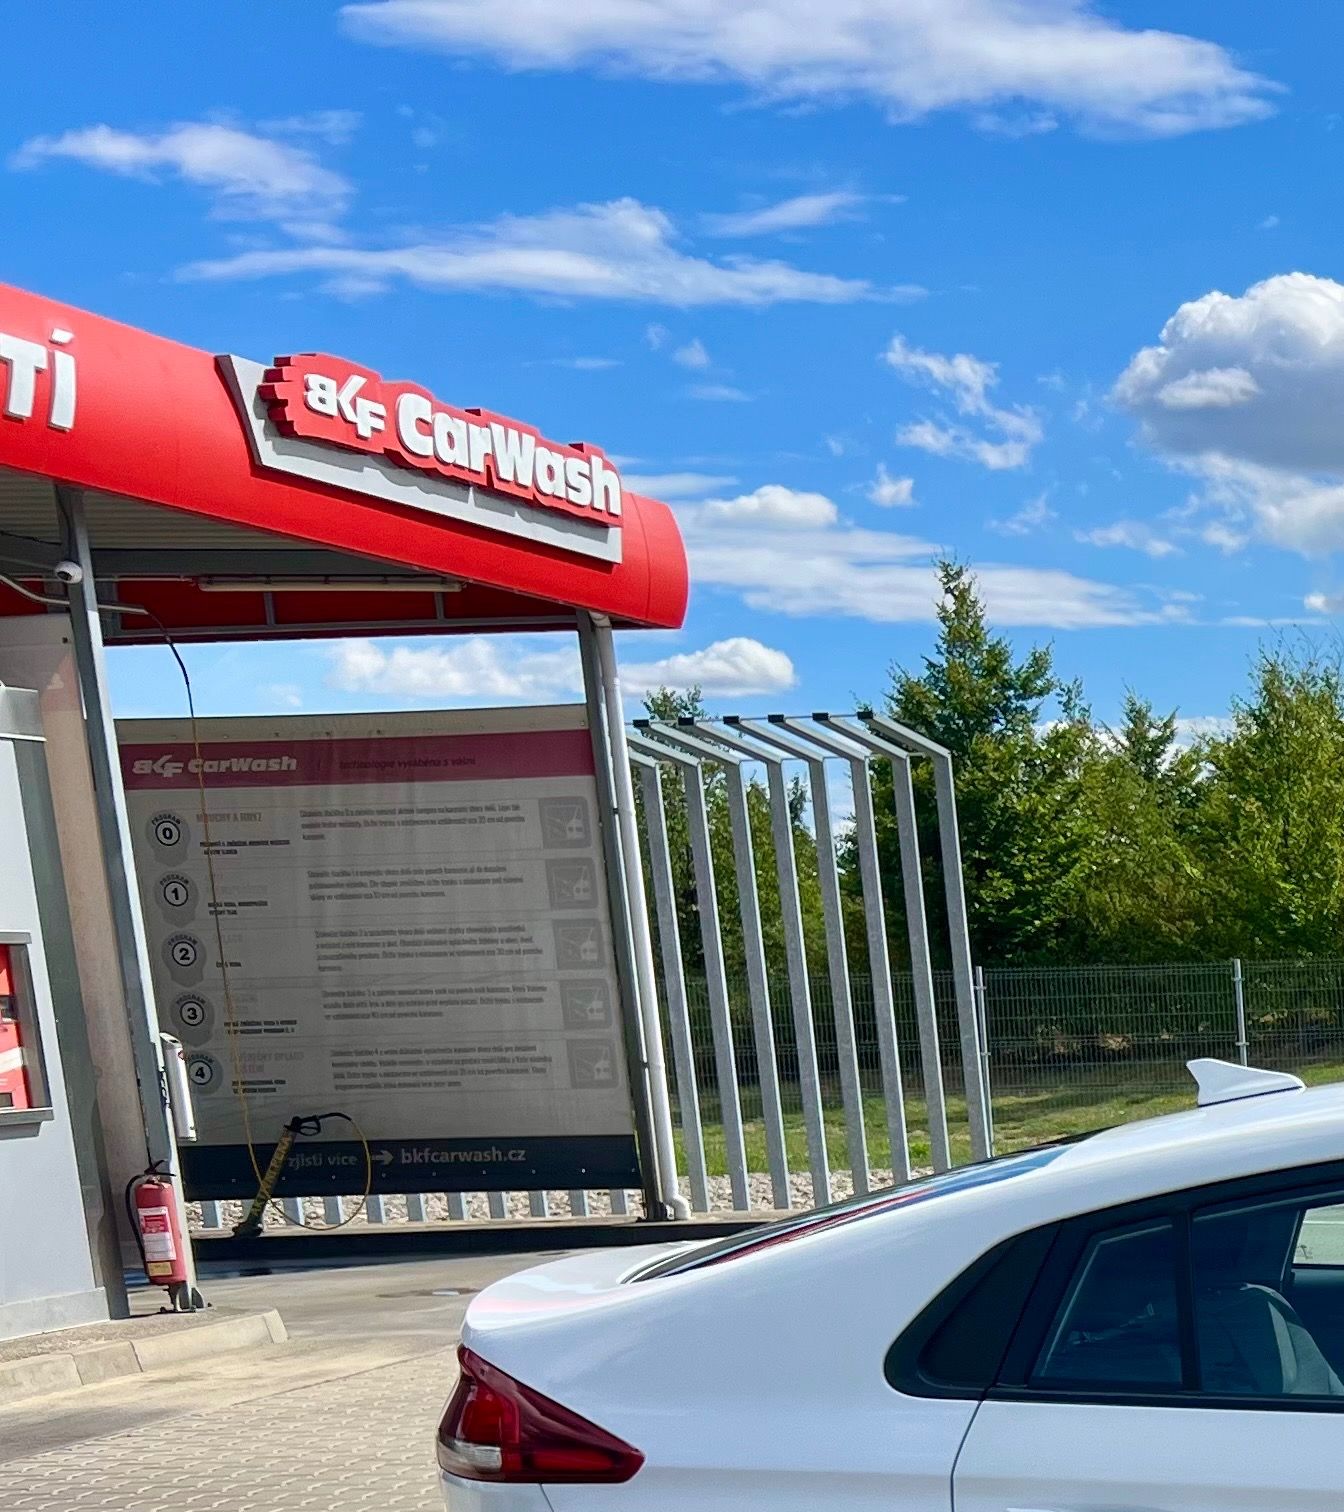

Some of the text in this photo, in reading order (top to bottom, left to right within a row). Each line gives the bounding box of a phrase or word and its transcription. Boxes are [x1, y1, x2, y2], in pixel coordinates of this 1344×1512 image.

[303, 373, 622, 517] BKF CarWash
[188, 756, 297, 773] CarWash
[162, 827, 173, 840] 0
[171, 888, 180, 901] 1
[179, 947, 190, 960] 2
[187, 1007, 198, 1020] 3
[195, 1066, 206, 1079] 4
[401, 1146, 527, 1164] bkfcarwash.cz
